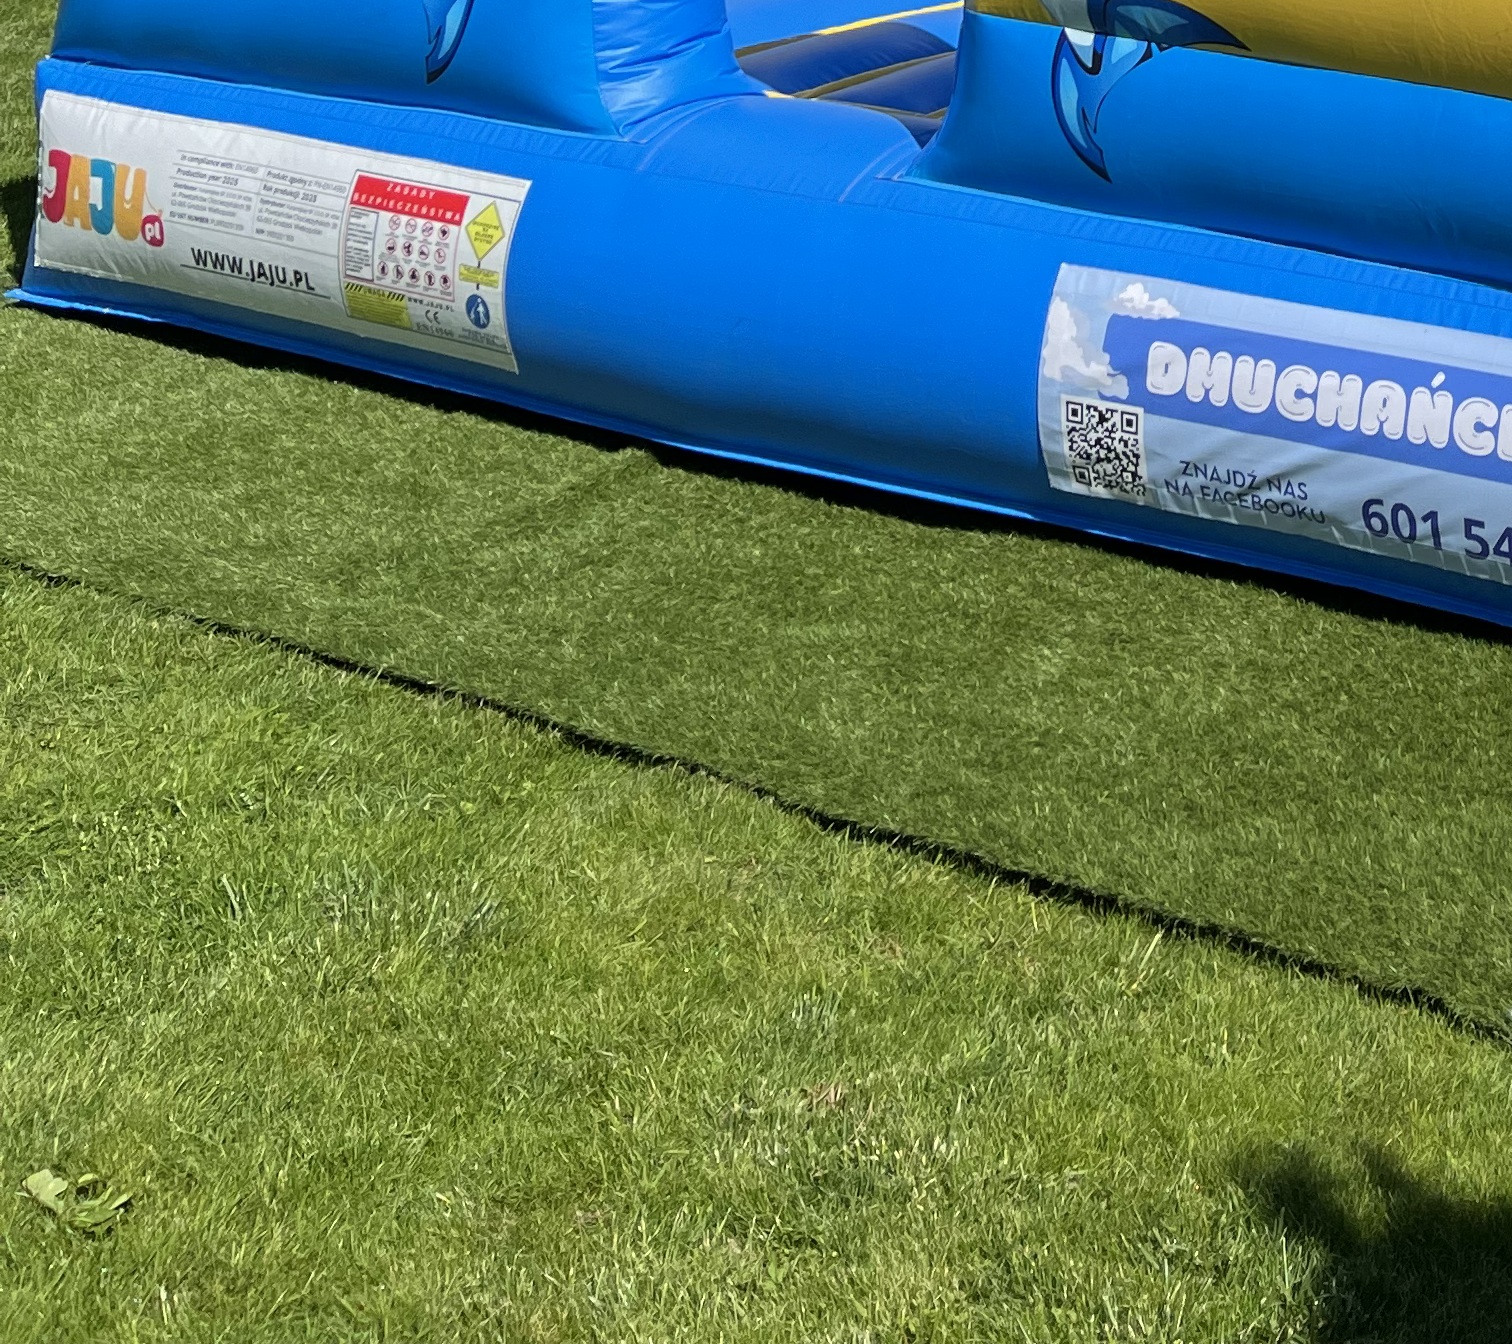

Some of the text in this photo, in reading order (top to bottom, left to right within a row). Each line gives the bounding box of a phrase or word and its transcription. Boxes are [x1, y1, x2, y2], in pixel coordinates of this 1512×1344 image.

[43, 148, 147, 242] JAJU
[386, 183, 436, 200] ZASADY
[190, 247, 315, 291] WWW.JAJU.PL
[1164, 478, 1326, 524] NA FACEBOOKU
[1179, 460, 1308, 501] ZNAJDŹ NAS
[1361, 498, 1443, 551] 601
